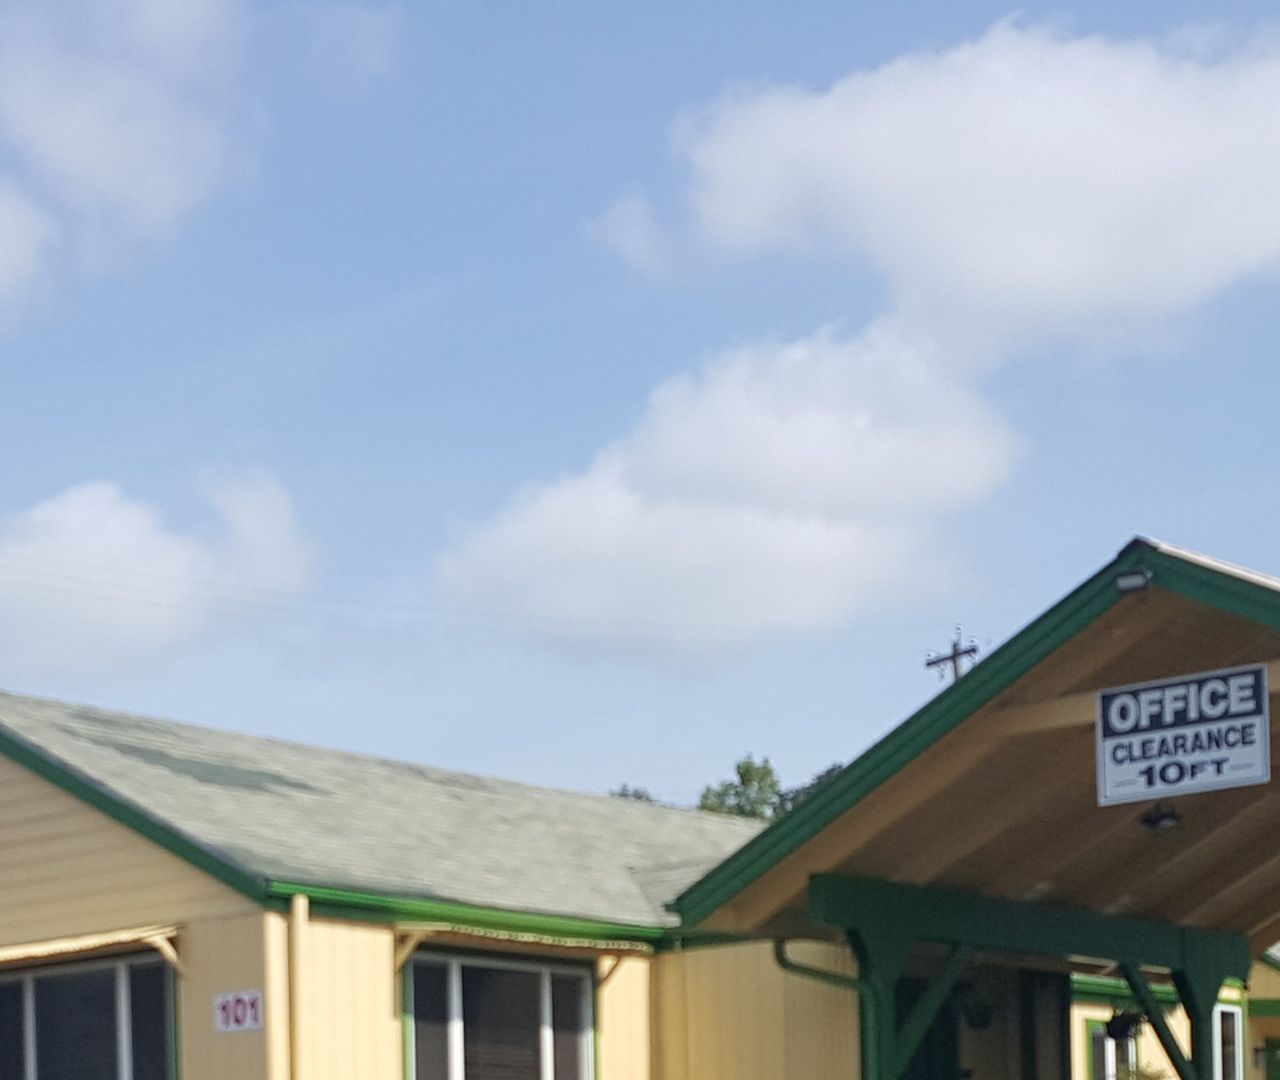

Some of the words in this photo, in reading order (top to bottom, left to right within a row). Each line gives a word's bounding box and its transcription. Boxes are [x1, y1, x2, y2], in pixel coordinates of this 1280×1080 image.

[1108, 674, 1257, 732] OFFICE
[1112, 723, 1256, 764] CLEARANCE
[219, 996, 259, 1028] 101
